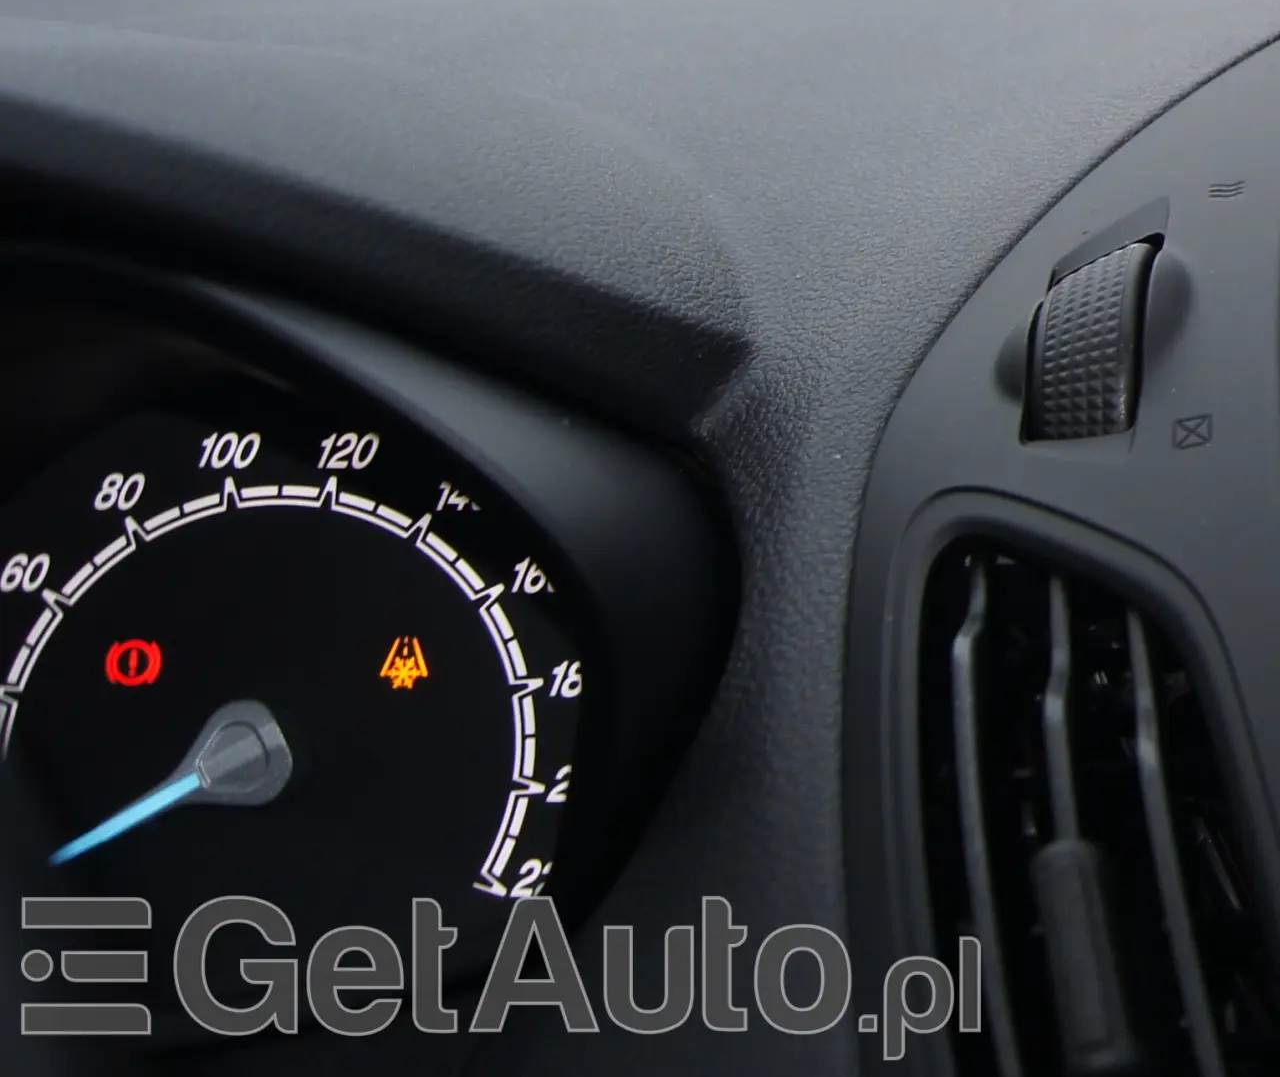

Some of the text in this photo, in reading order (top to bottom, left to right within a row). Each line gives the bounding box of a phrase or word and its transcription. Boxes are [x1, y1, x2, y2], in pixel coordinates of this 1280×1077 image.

[199, 431, 261, 469] 100
[317, 431, 380, 469] 120
[94, 472, 146, 511] 80
[436, 481, 481, 512] 14
[0, 552, 51, 593] 60
[511, 556, 555, 594] 16
[550, 660, 582, 698] 18
